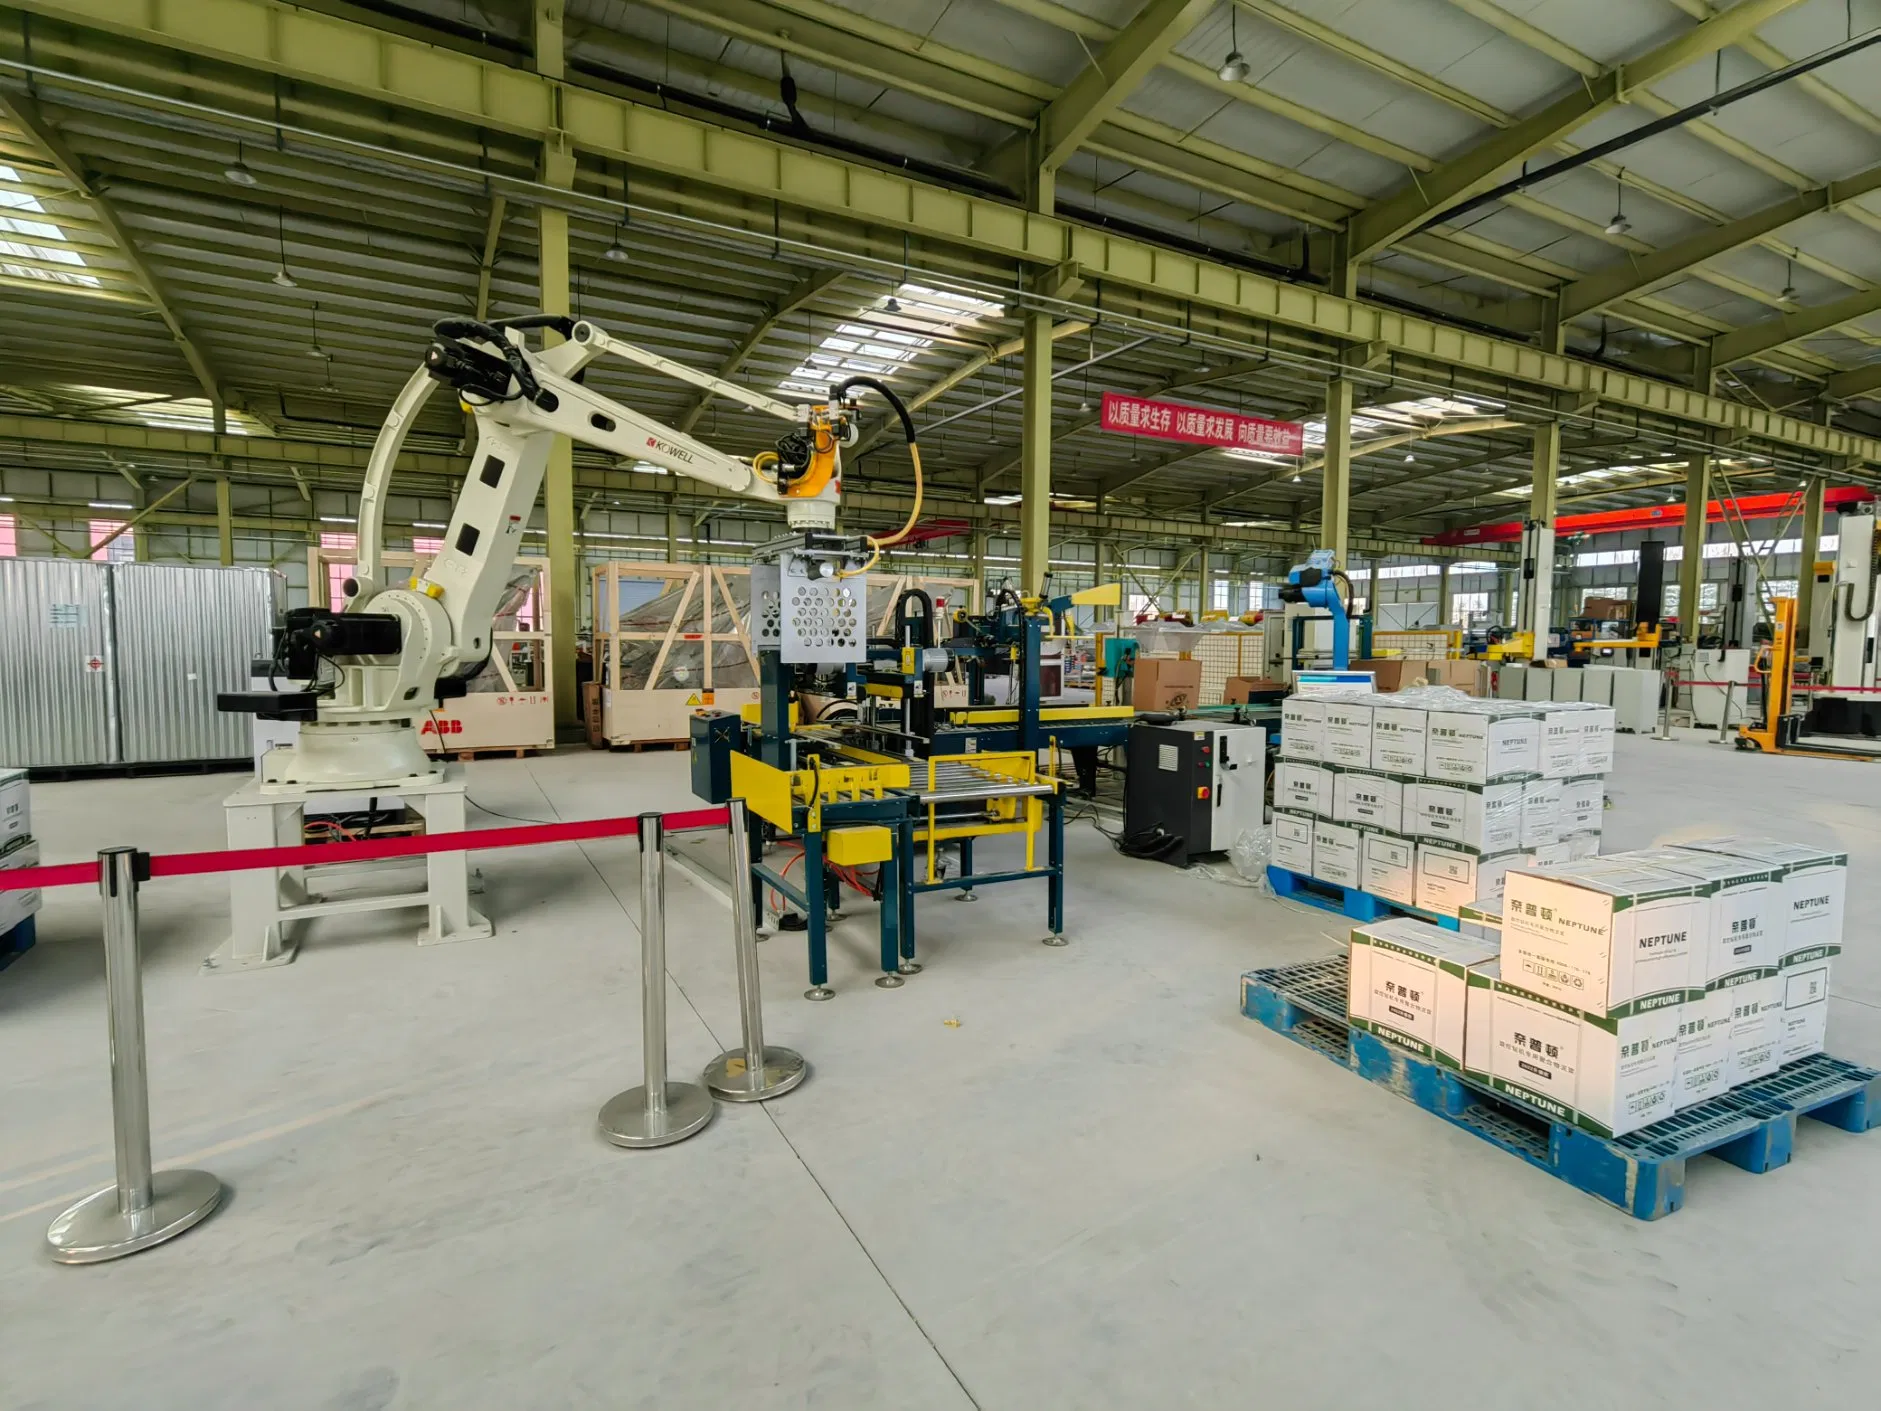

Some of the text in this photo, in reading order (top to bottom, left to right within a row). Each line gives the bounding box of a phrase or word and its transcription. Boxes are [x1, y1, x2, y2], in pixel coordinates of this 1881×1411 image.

[1108, 400, 1172, 431] 以质量求生存
[1176, 411, 1234, 440] 以质量求发展
[656, 441, 693, 464] KOWELL
[421, 720, 463, 735] ABB
[1423, 838, 1457, 848] NEPTUNE
[1793, 896, 1830, 910] NEPTUNE
[1511, 899, 1552, 920] 奈普顿
[1558, 918, 1604, 936] NEPTUNE
[1639, 931, 1687, 948] NEPTUNE
[1793, 949, 1823, 962] NEPTUNE
[1724, 972, 1758, 988] NEPTUNE
[1385, 980, 1420, 1002] 奈普顿
[1640, 994, 1680, 1010] NEPTUNE
[1378, 1027, 1424, 1052] NEPTUNE
[1514, 1032, 1559, 1059] 奈普顿
[1505, 1084, 1566, 1117] NEPTUNE
